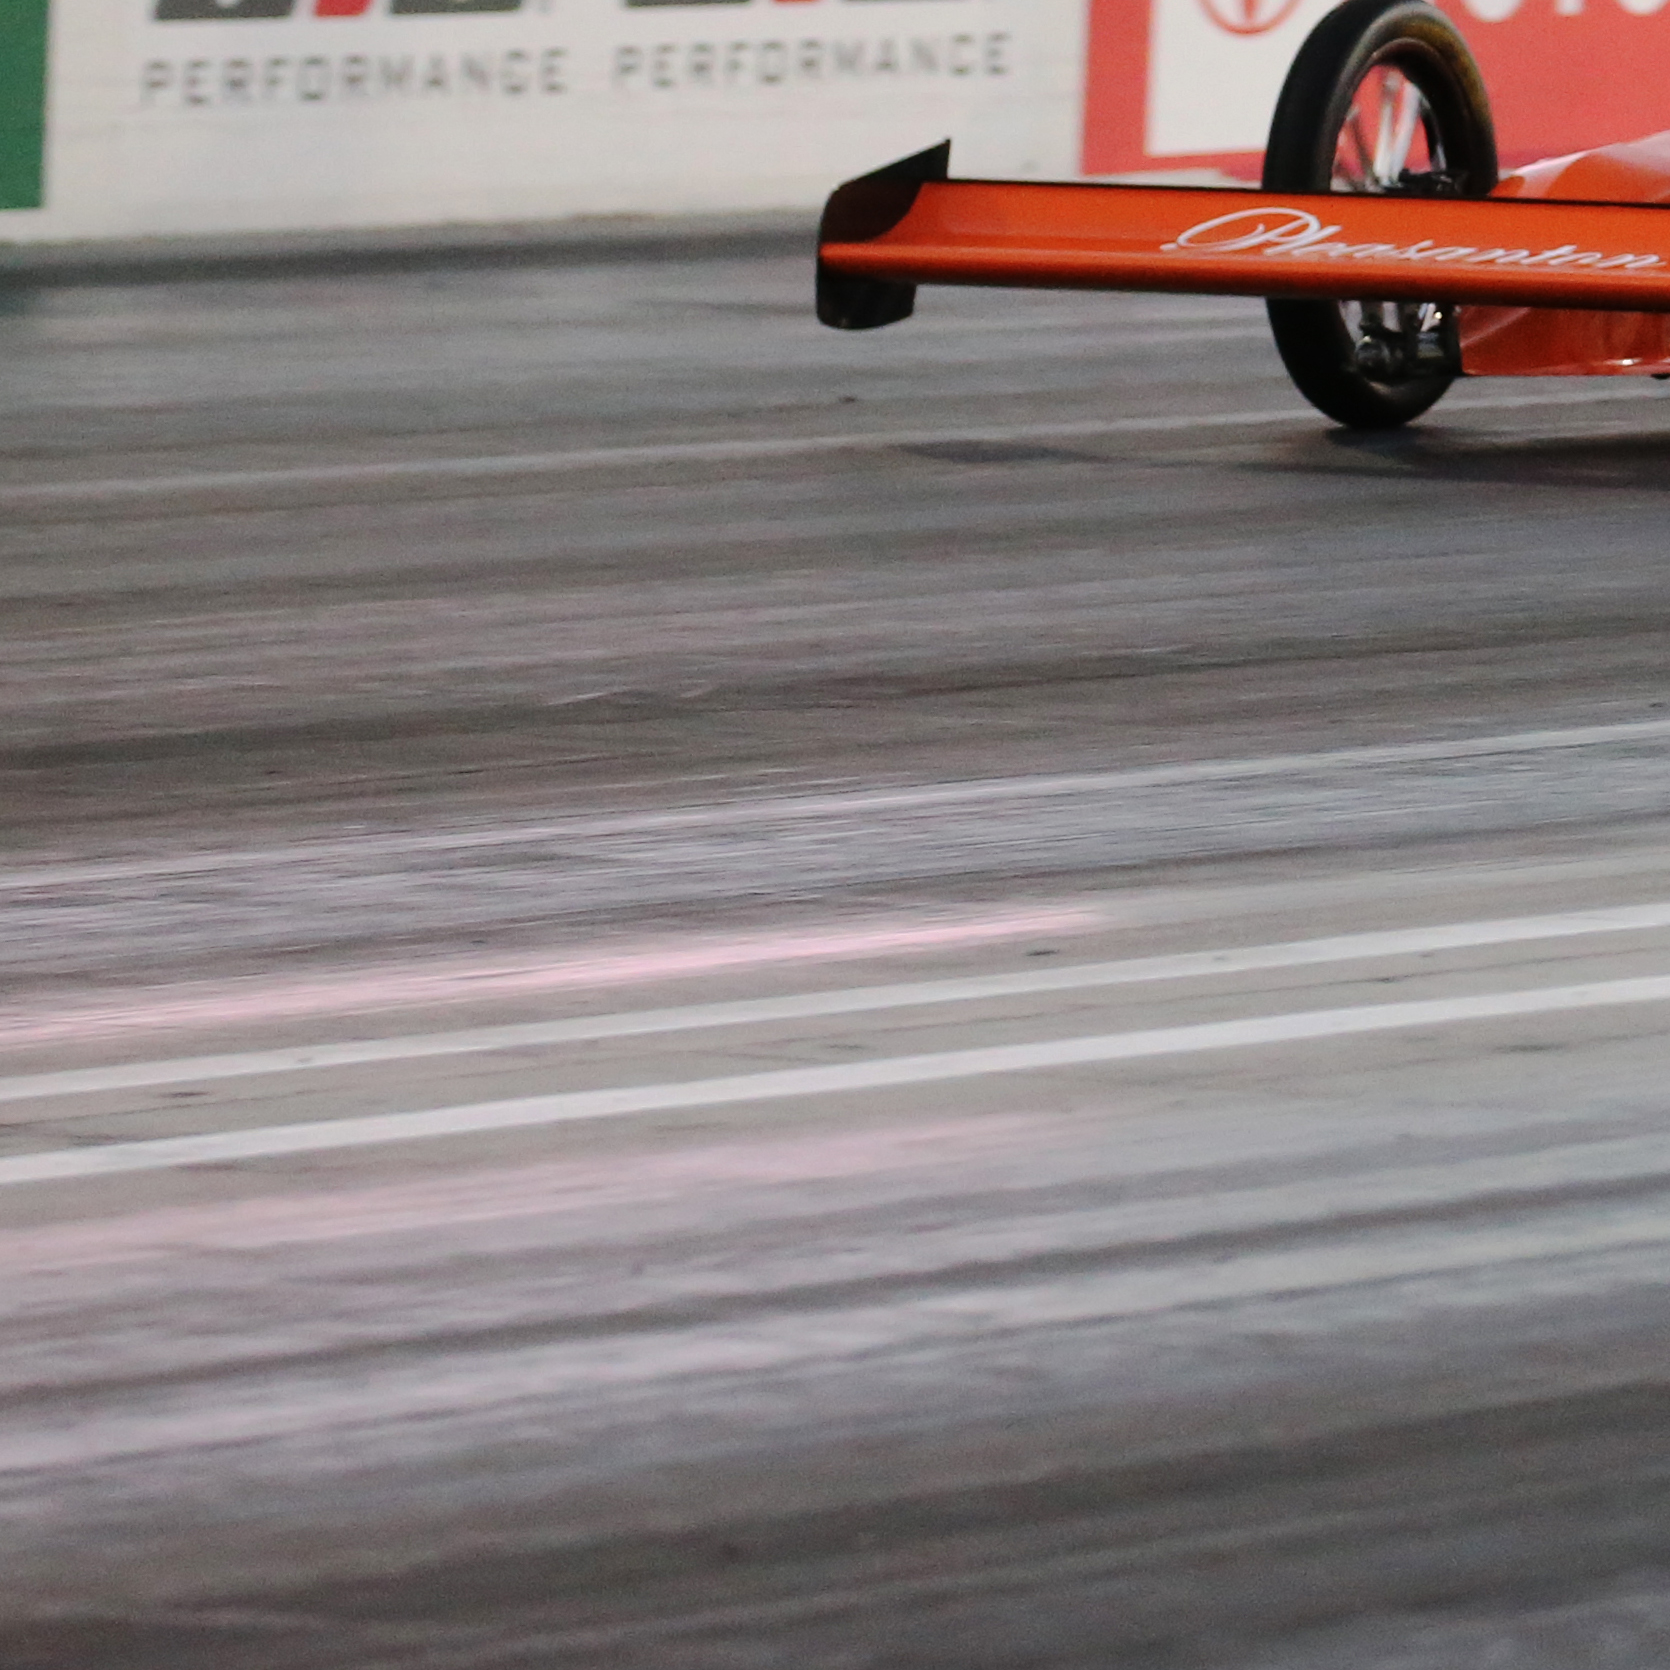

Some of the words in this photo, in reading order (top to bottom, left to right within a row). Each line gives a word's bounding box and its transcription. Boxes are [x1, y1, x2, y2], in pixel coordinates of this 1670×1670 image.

[143, 47, 570, 105] PERFORMANCE
[613, 33, 1014, 90] PERFORMANCE
[1159, 206, 1667, 270] Pleasanton
